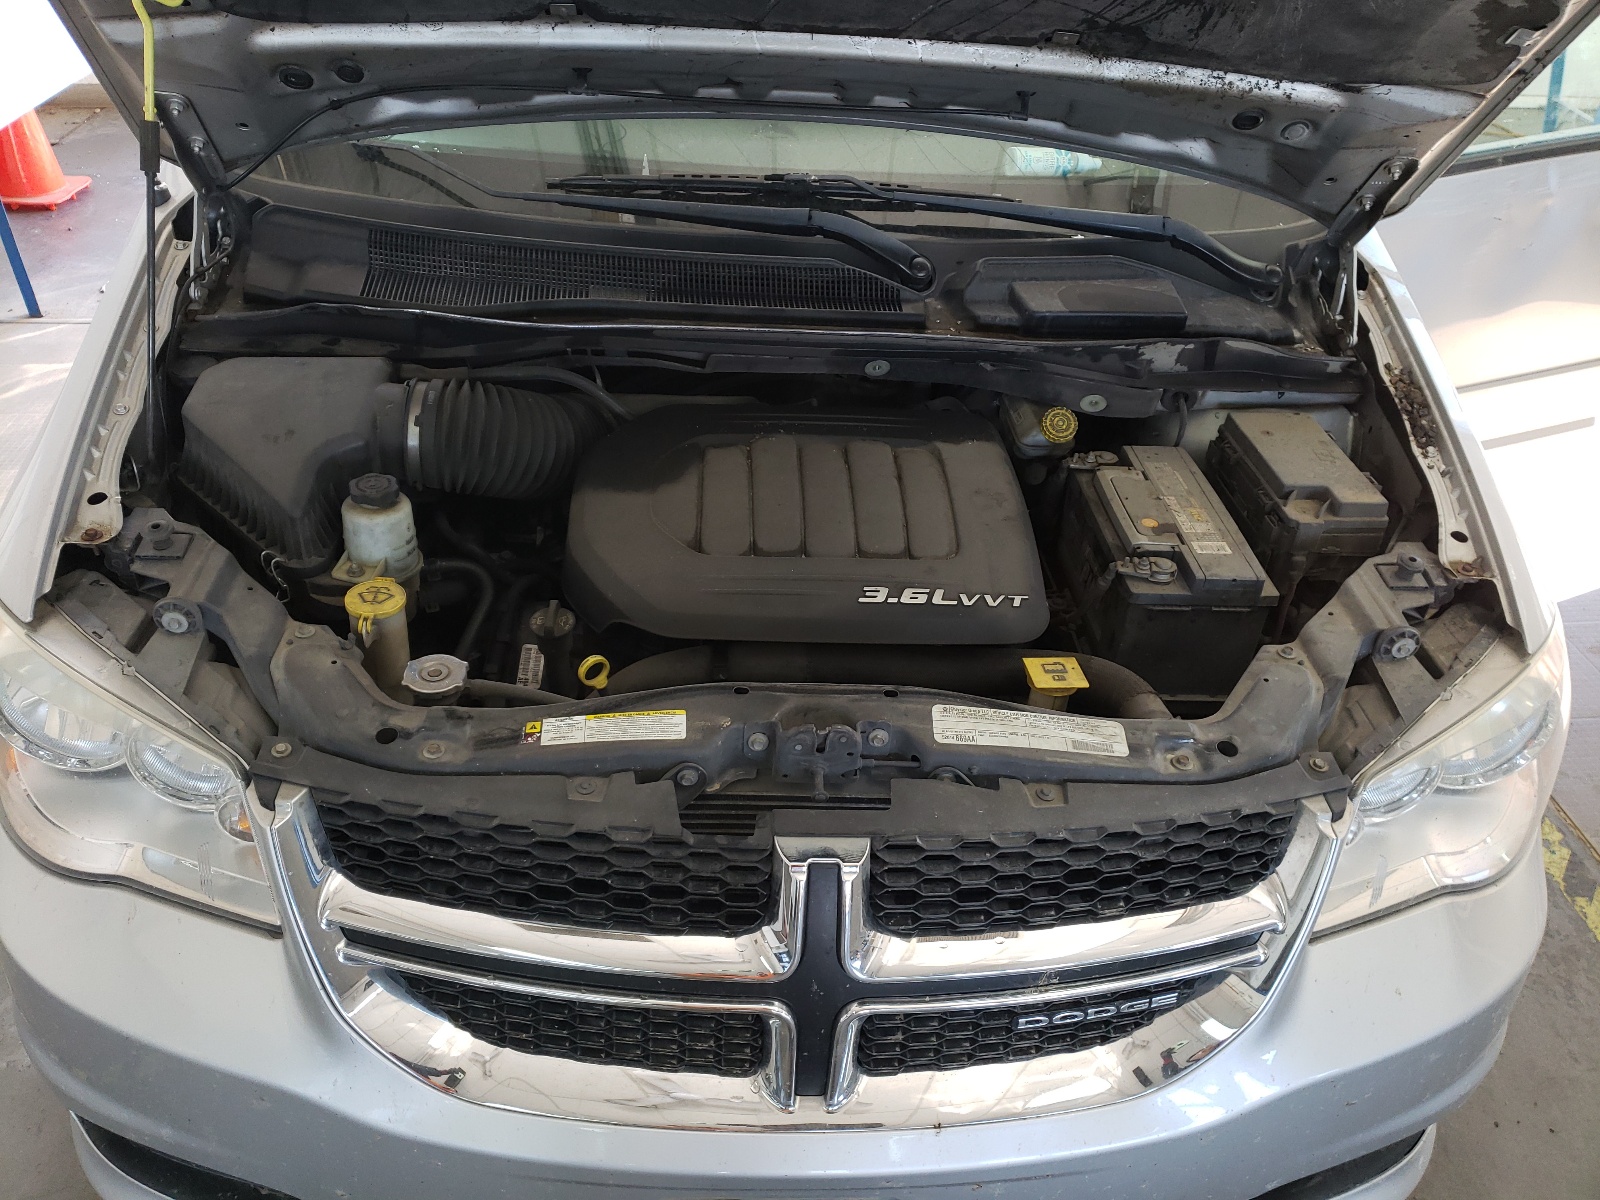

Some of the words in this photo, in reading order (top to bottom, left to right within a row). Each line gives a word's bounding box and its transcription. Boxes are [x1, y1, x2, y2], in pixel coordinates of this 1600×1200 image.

[858, 586, 958, 605] 3.6L
[959, 593, 1029, 607] VVT
[1017, 992, 1179, 1029] DODGE
